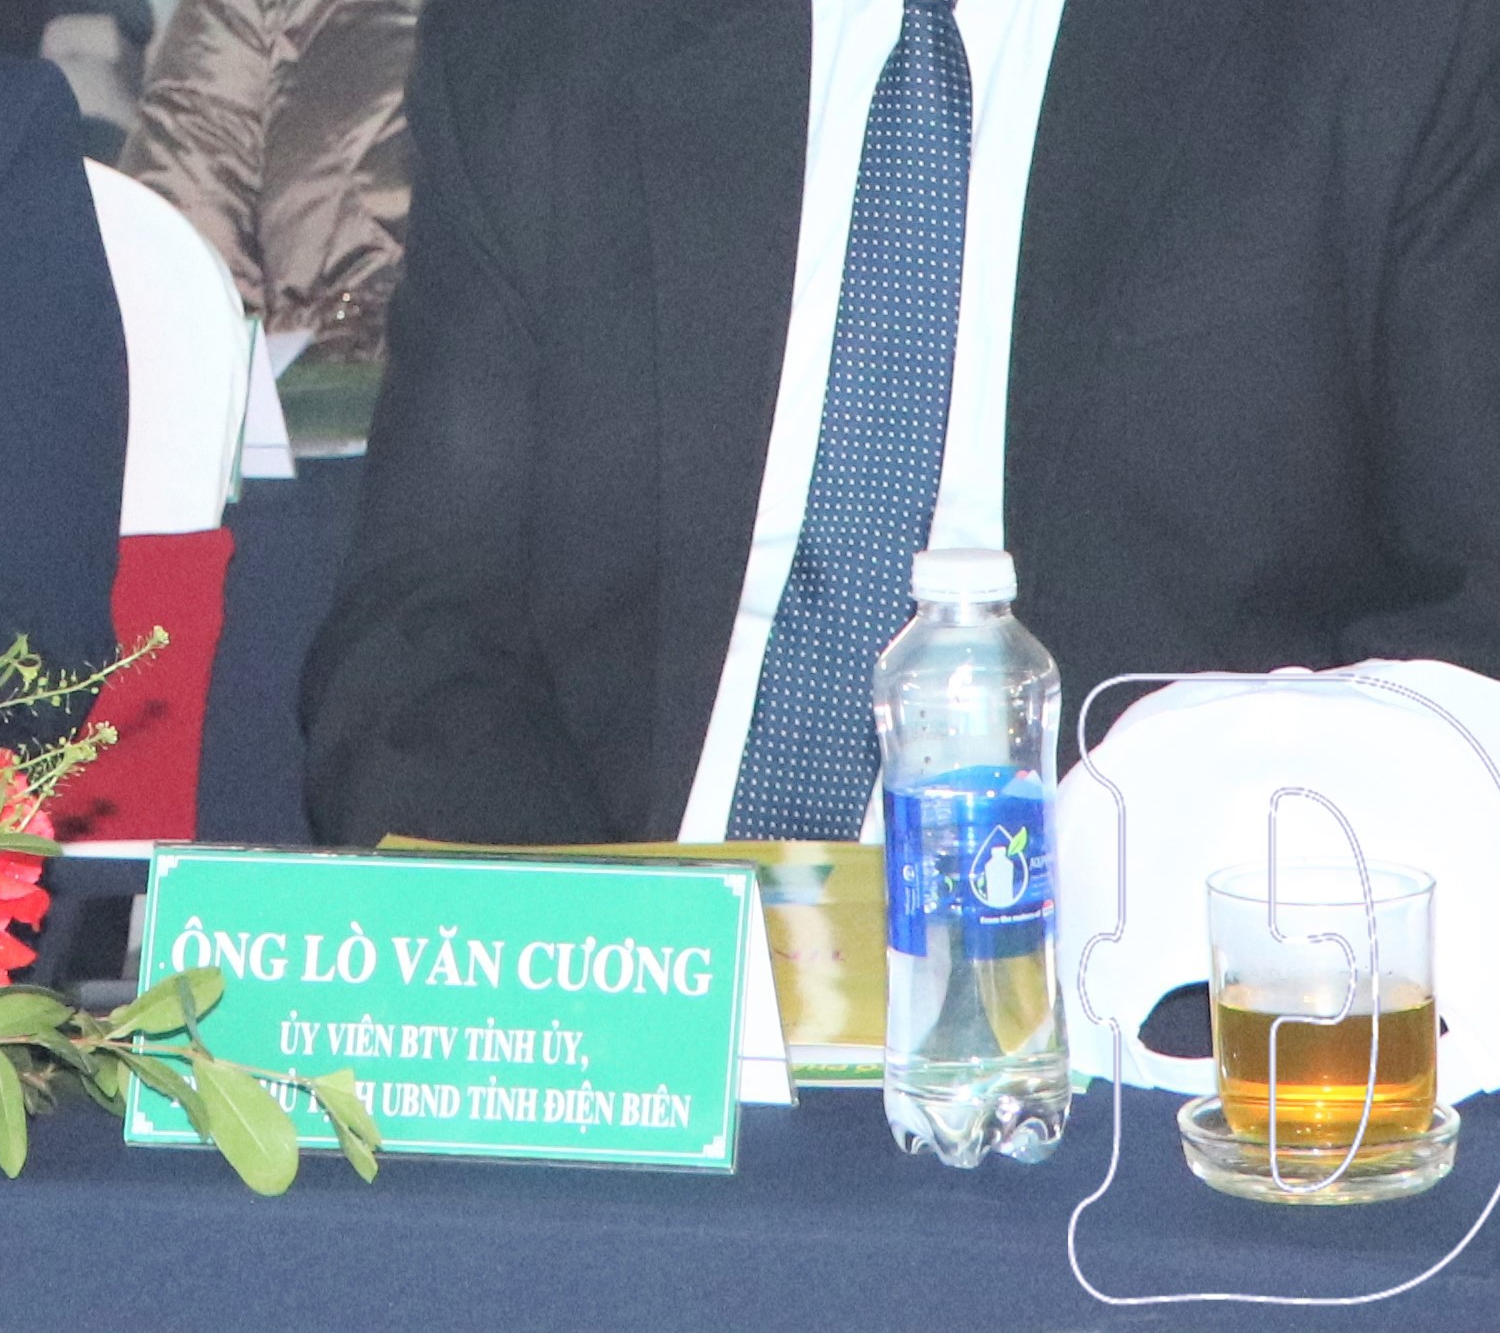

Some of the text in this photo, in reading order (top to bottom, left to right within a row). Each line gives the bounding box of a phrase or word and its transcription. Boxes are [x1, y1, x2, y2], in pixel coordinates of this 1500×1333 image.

[171, 916, 713, 996] ÔNG LÒ VĂN CƯƠNG
[280, 1010, 589, 1072] ỦY VIÊN BTV TỈNH ỦY,
[381, 1082, 461, 1121] UBND
[467, 1076, 538, 1122] TỈNH
[543, 1080, 615, 1134] ĐIỆN
[620, 1084, 692, 1129] BIÊN
